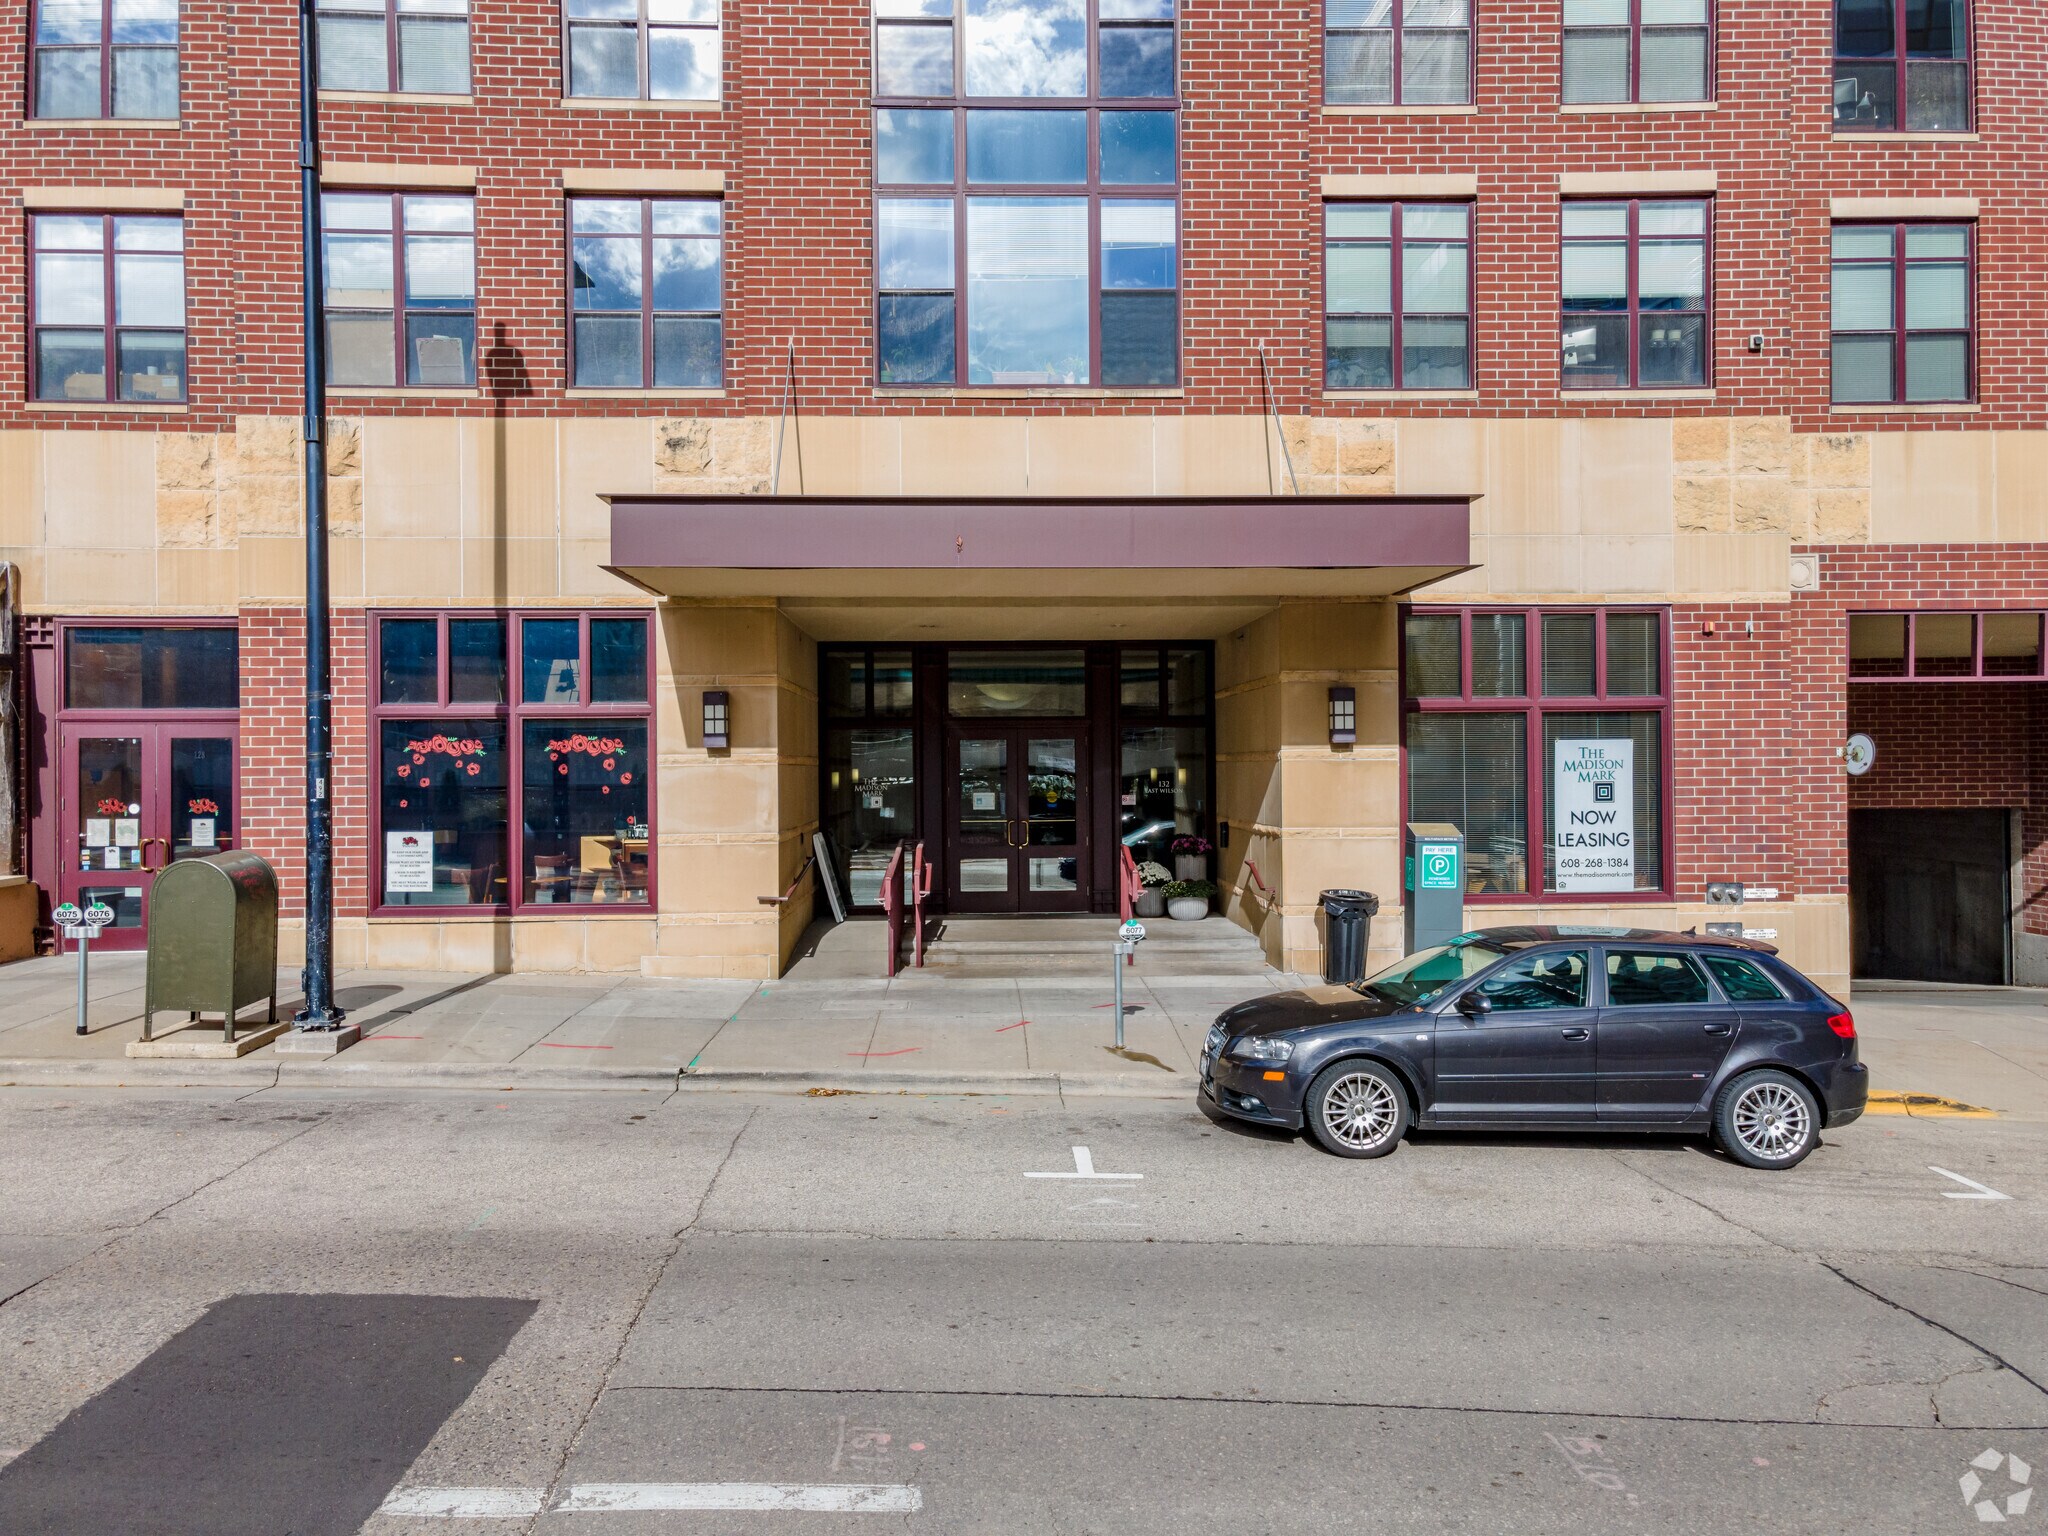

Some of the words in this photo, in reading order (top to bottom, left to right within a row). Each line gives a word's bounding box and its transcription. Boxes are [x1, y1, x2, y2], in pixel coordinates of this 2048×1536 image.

[1578, 747, 1604, 758] THE
[1563, 760, 1623, 772] MADISON
[1578, 770, 1615, 782] MARK
[1158, 780, 1170, 788] 132
[1571, 810, 1617, 825] NOW
[1558, 832, 1630, 847] LEASING
[1435, 859, 1445, 872] P
[1560, 858, 1629, 868] 608-268-1384
[56, 910, 78, 918] 6075
[87, 910, 110, 918] 6076
